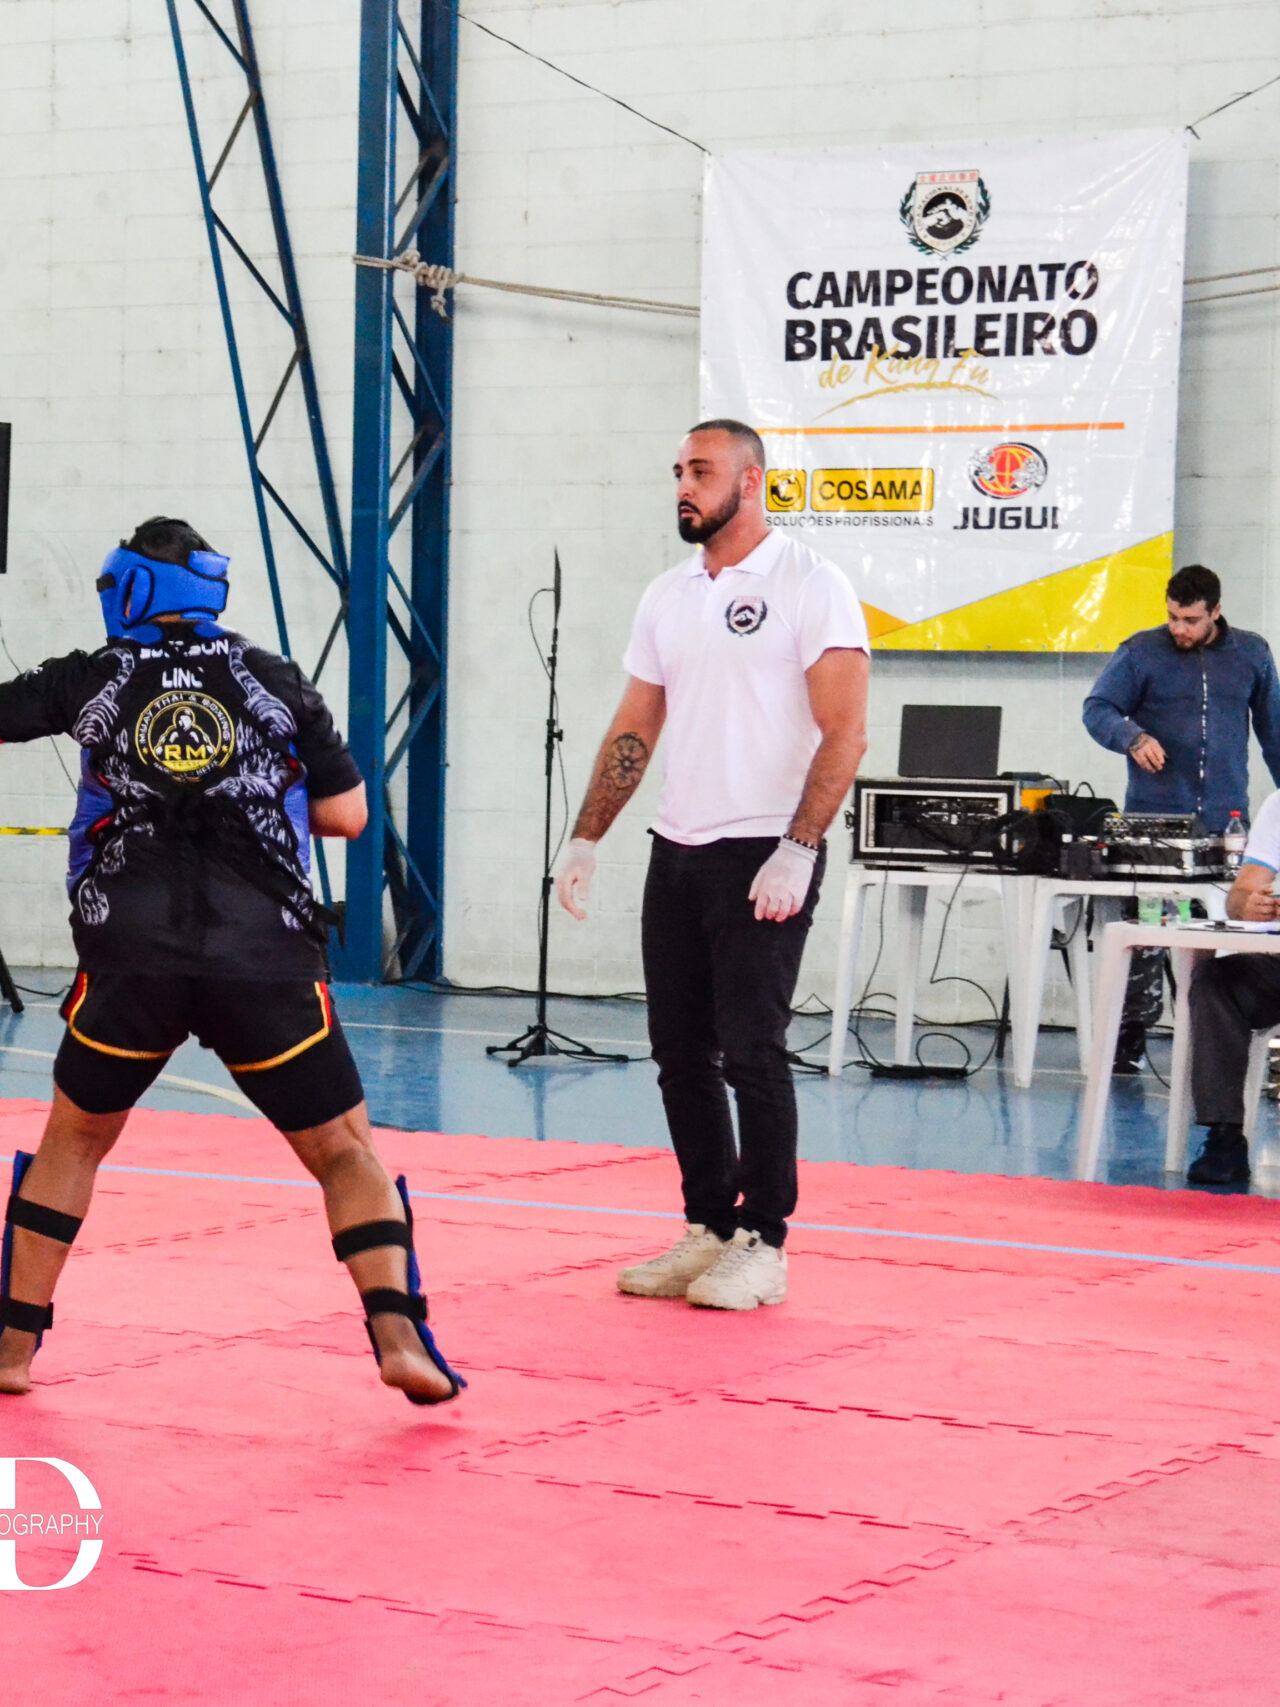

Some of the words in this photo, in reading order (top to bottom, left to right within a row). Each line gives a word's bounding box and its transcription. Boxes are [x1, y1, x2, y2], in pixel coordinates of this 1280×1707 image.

[786, 260, 1099, 310] CAMPEONATO
[784, 309, 1098, 361] BRASILEIRO
[819, 353, 855, 388] de
[864, 343, 940, 384] Kung
[948, 347, 990, 384] Fu
[819, 480, 925, 501] COSAMA
[835, 516, 933, 527] PROFISSIONAS
[953, 506, 1059, 530] JUGUI
[139, 710, 153, 744] MUAY
[154, 693, 184, 709] THAI
[202, 698, 231, 741] BOXING
[164, 744, 207, 761] RM
